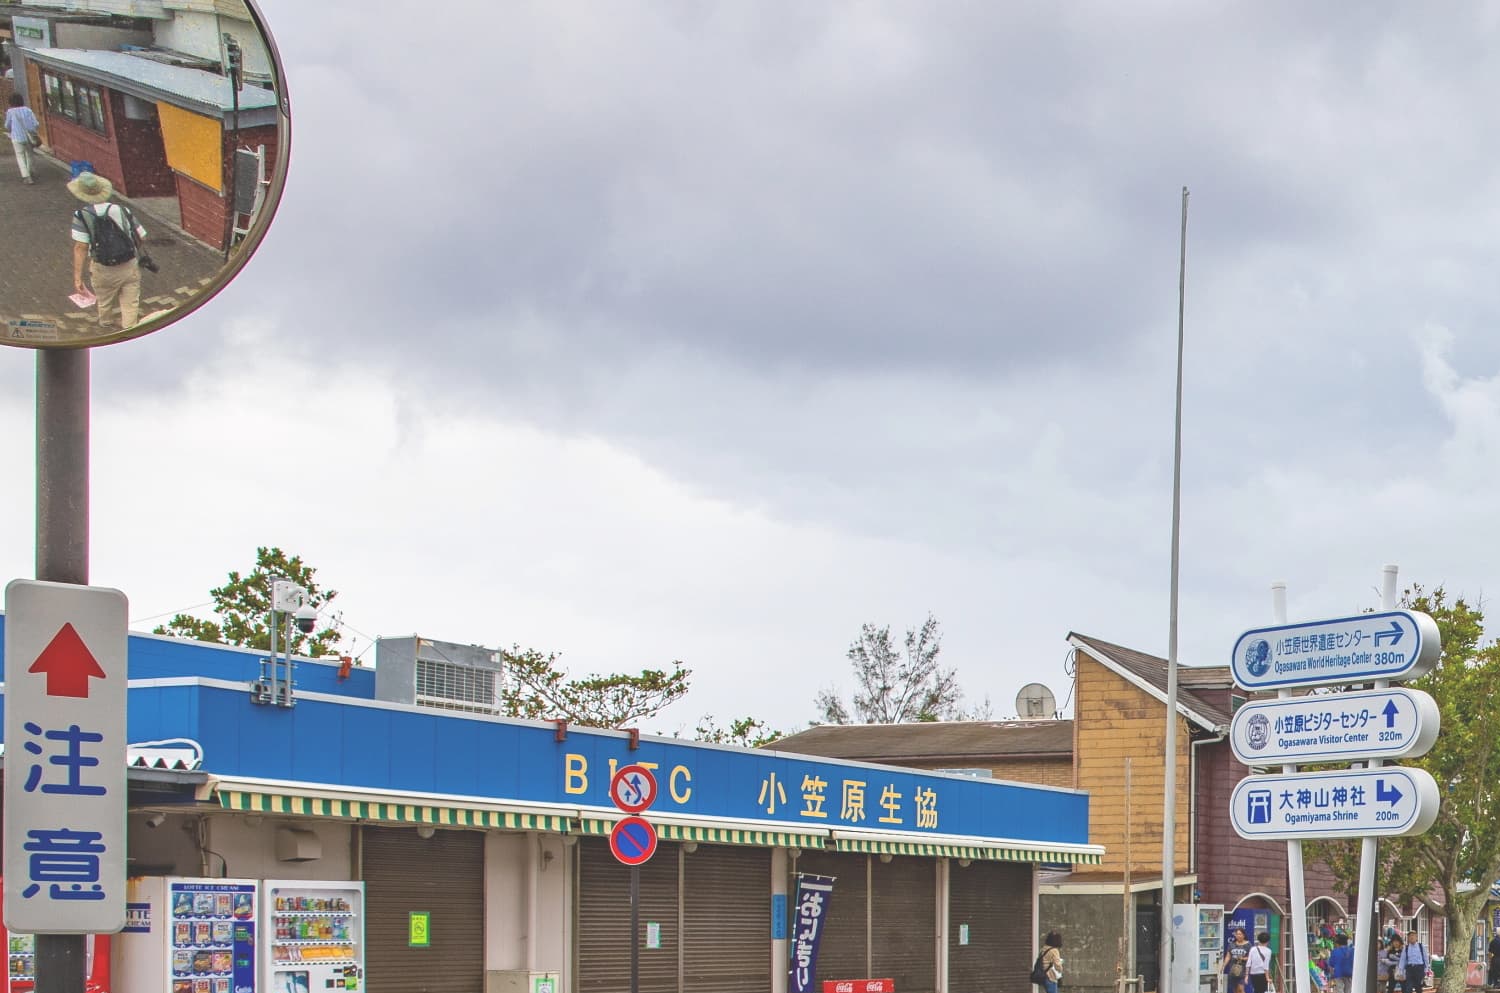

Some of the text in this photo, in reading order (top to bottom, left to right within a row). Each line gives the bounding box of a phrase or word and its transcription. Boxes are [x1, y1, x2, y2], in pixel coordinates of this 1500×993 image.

[1276, 630, 1371, 656] 小笠原世界遺産センター
[1274, 651, 1372, 675] Ogasawara World Heritage Center
[1374, 651, 1405, 666] 380m
[1274, 709, 1377, 734] 小笠原ビジターセンター
[1278, 737, 1318, 749] Ogasawara
[1319, 735, 1342, 745] Visitor
[1343, 733, 1369, 743] Center
[1378, 731, 1403, 742] 320m
[564, 753, 692, 805] BC
[758, 772, 938, 829] 小笠原生協
[1279, 785, 1366, 810] 大神山神社
[22, 721, 107, 901] 注意
[1284, 811, 1359, 825] Ogamiyama Shrine
[1375, 811, 1400, 821] 200m
[126, 910, 152, 919] TTE
